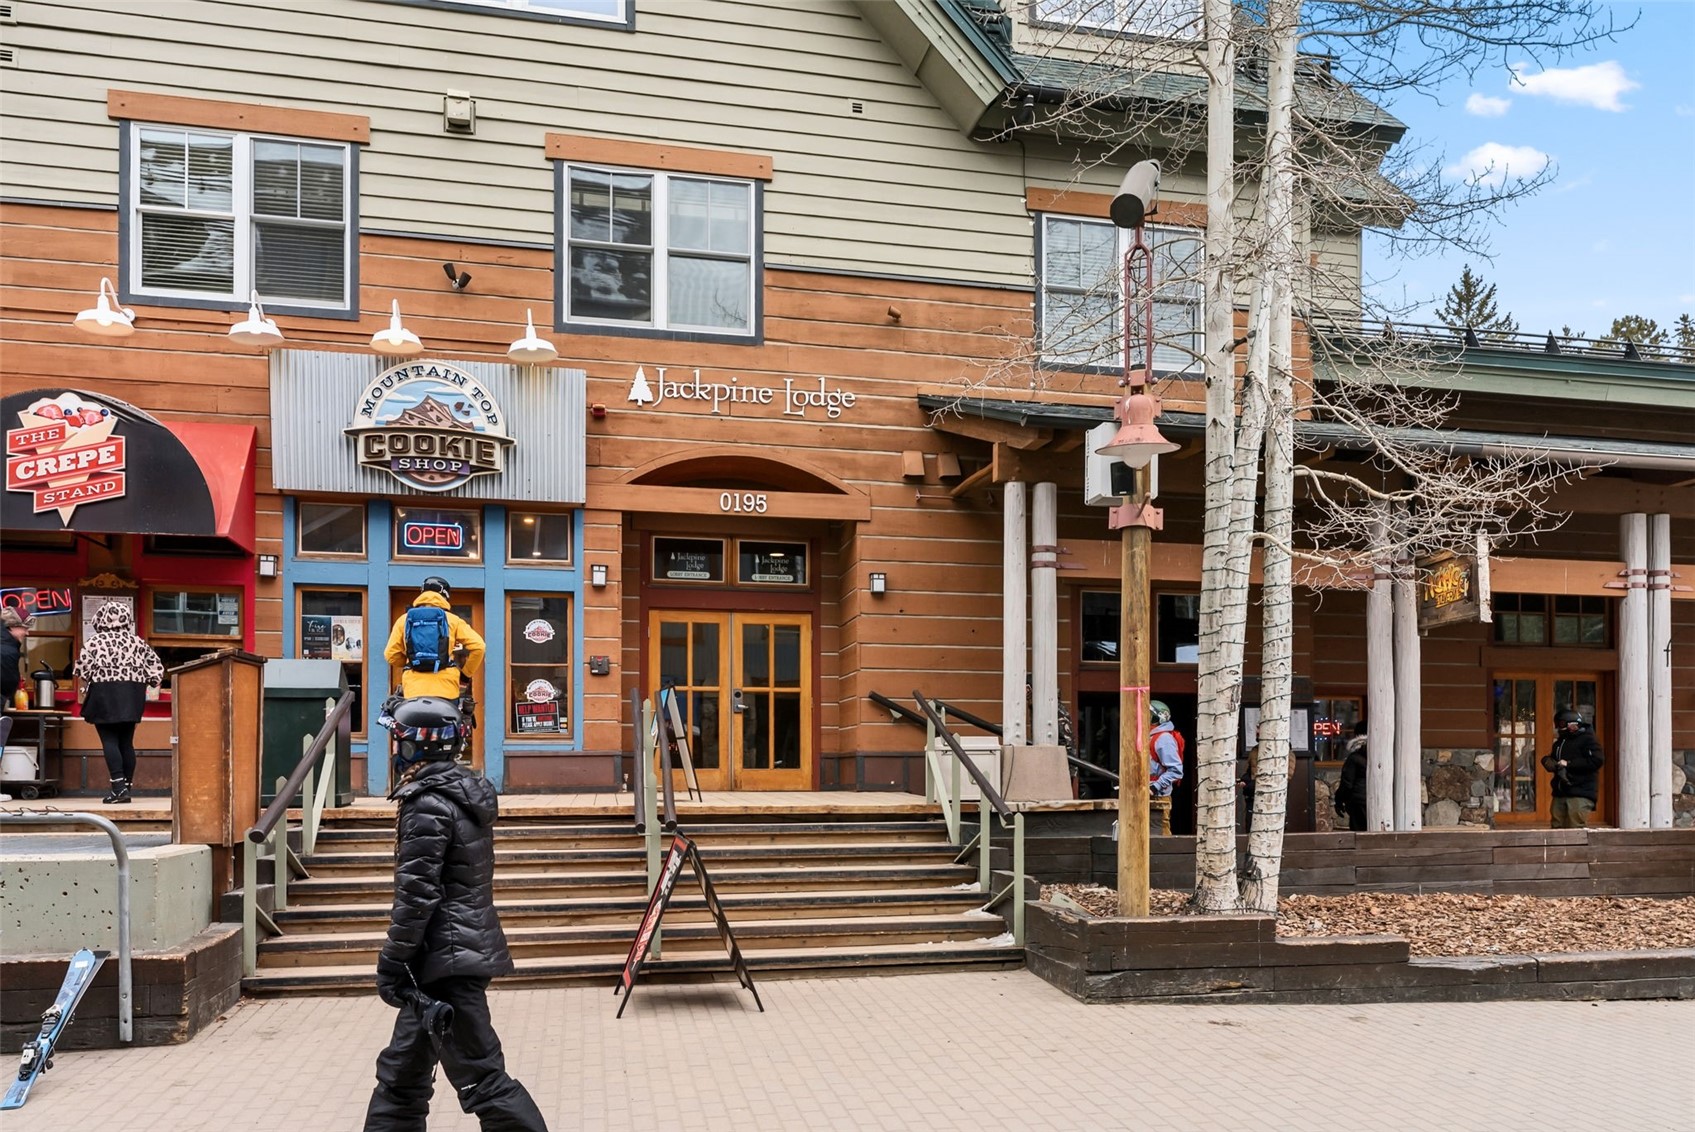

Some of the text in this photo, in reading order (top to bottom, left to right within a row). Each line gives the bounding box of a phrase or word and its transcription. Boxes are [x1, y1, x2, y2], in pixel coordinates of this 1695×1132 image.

[360, 365, 499, 428] MOUNTAIN TOP
[652, 367, 857, 419] Jackpine Lodge
[15, 428, 60, 446] THE
[364, 433, 496, 466] COOKIE
[15, 445, 117, 480] CREPE
[398, 458, 464, 472] SHOP
[43, 481, 117, 505] STAND
[719, 492, 768, 513] 0195
[406, 526, 460, 547] OPEN
[677, 552, 706, 562] Jackpine
[685, 561, 705, 571] Lodge
[761, 556, 790, 566] Jackpine
[770, 564, 788, 574] Lodge
[2, 589, 70, 610] OPEN
[1313, 722, 1341, 735] PEN
